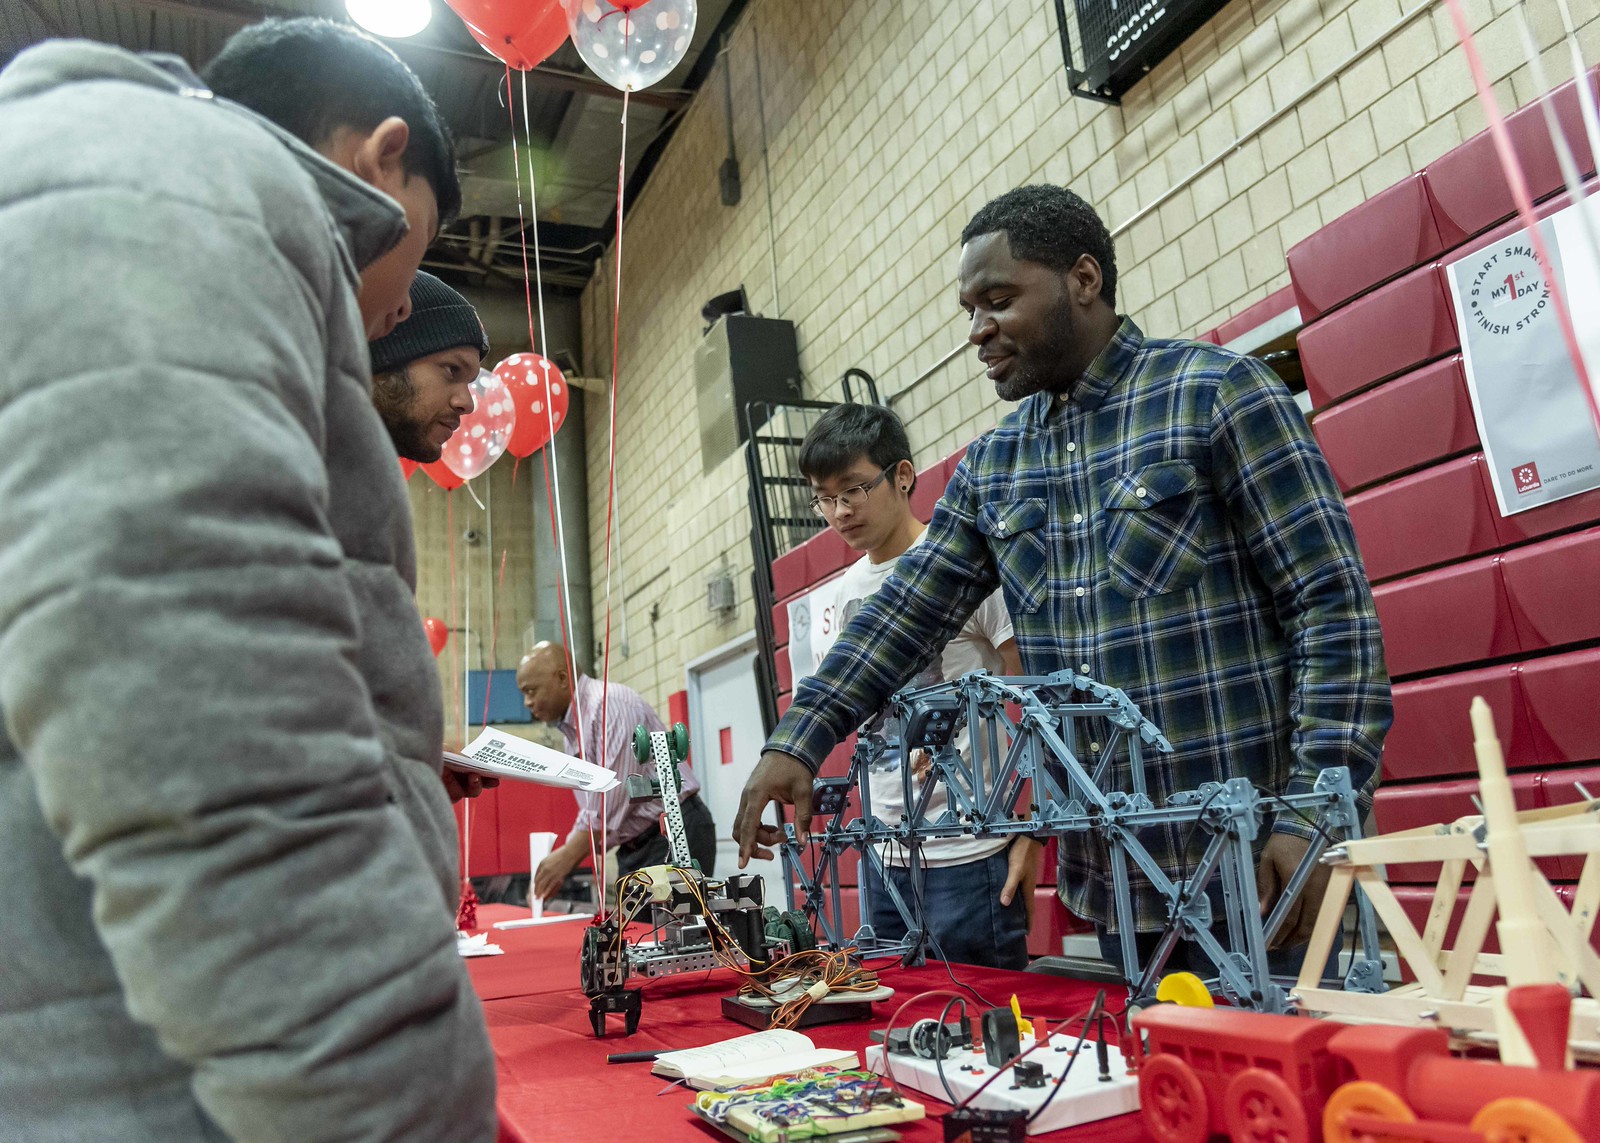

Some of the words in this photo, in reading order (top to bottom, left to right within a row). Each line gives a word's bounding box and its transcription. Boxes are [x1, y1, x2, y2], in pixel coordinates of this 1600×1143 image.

[1472, 255, 1498, 296] START
[1505, 246, 1544, 266] SMAR
[1491, 286, 1507, 299] MY
[1517, 281, 1539, 297] DAY
[1474, 310, 1509, 334] FINISH
[1544, 476, 1558, 484] DARE
[1576, 464, 1593, 473] MORE
[481, 746, 507, 758] RED
[507, 755, 548, 771] HAWK
